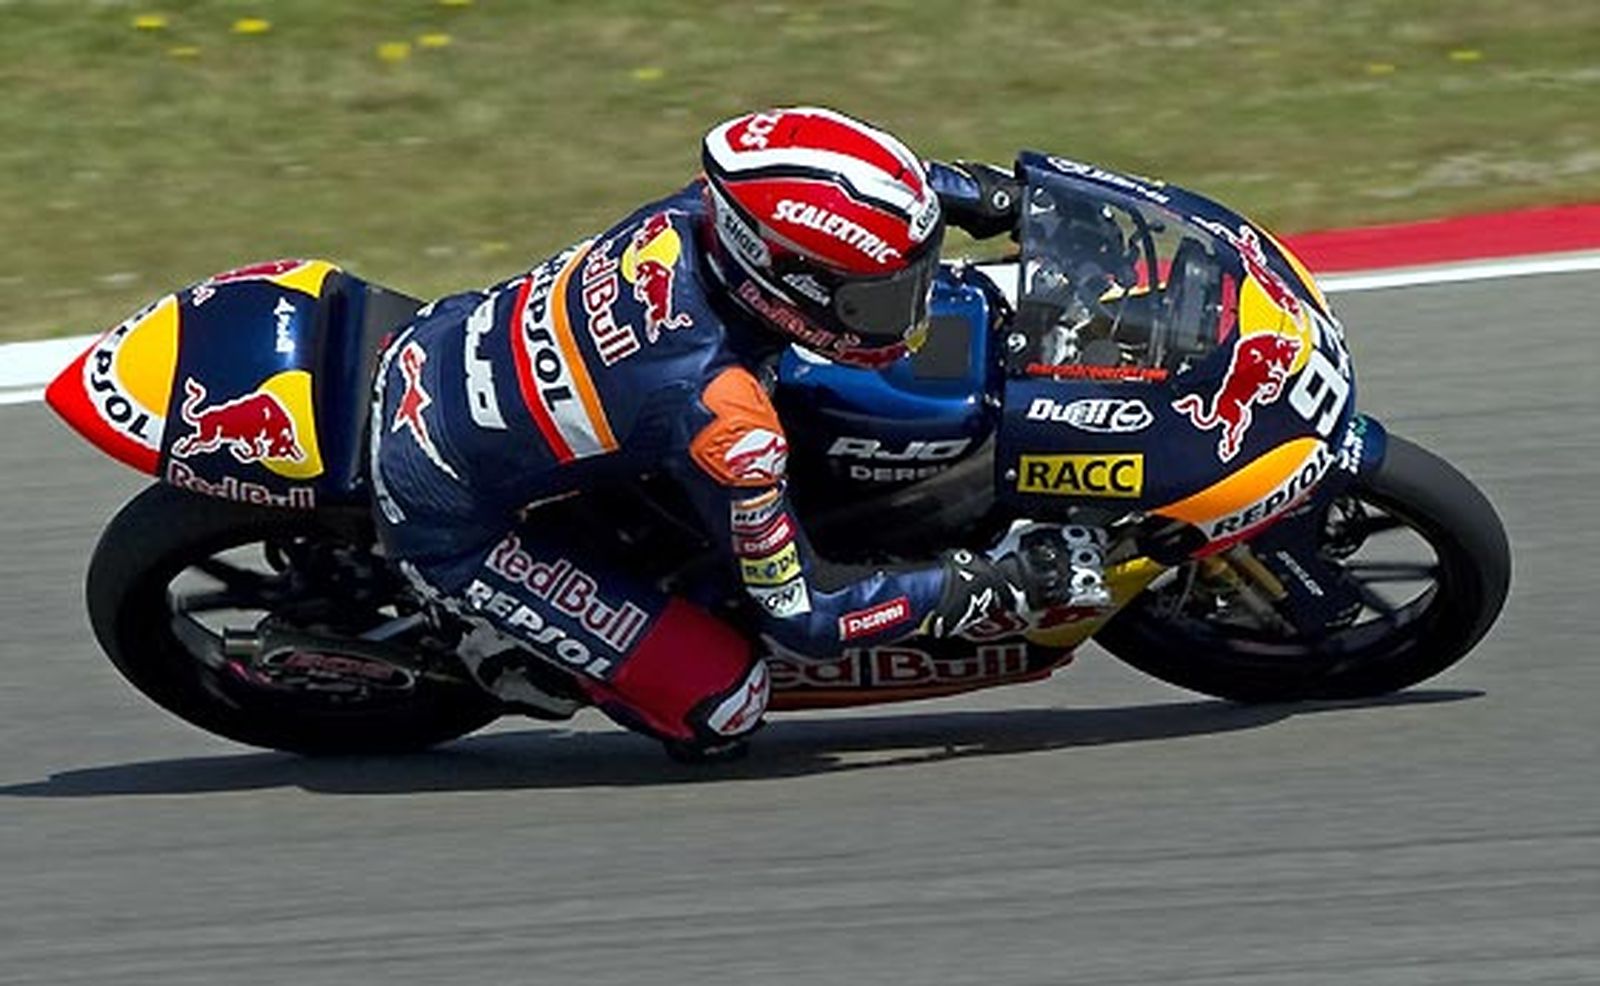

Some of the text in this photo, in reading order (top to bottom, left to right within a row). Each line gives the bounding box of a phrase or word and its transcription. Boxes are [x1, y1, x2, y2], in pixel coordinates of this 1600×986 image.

[771, 199, 901, 264] SCALEXTRIC
[583, 272, 641, 368] Bull
[90, 322, 148, 440] PSOL
[1025, 460, 1135, 492] RACC
[1211, 449, 1329, 539] REPSOL
[466, 579, 613, 680] REPSOL
[485, 533, 650, 653] Red Bull
[849, 604, 905, 633] DERBI
[768, 644, 1028, 688] ed Bull
